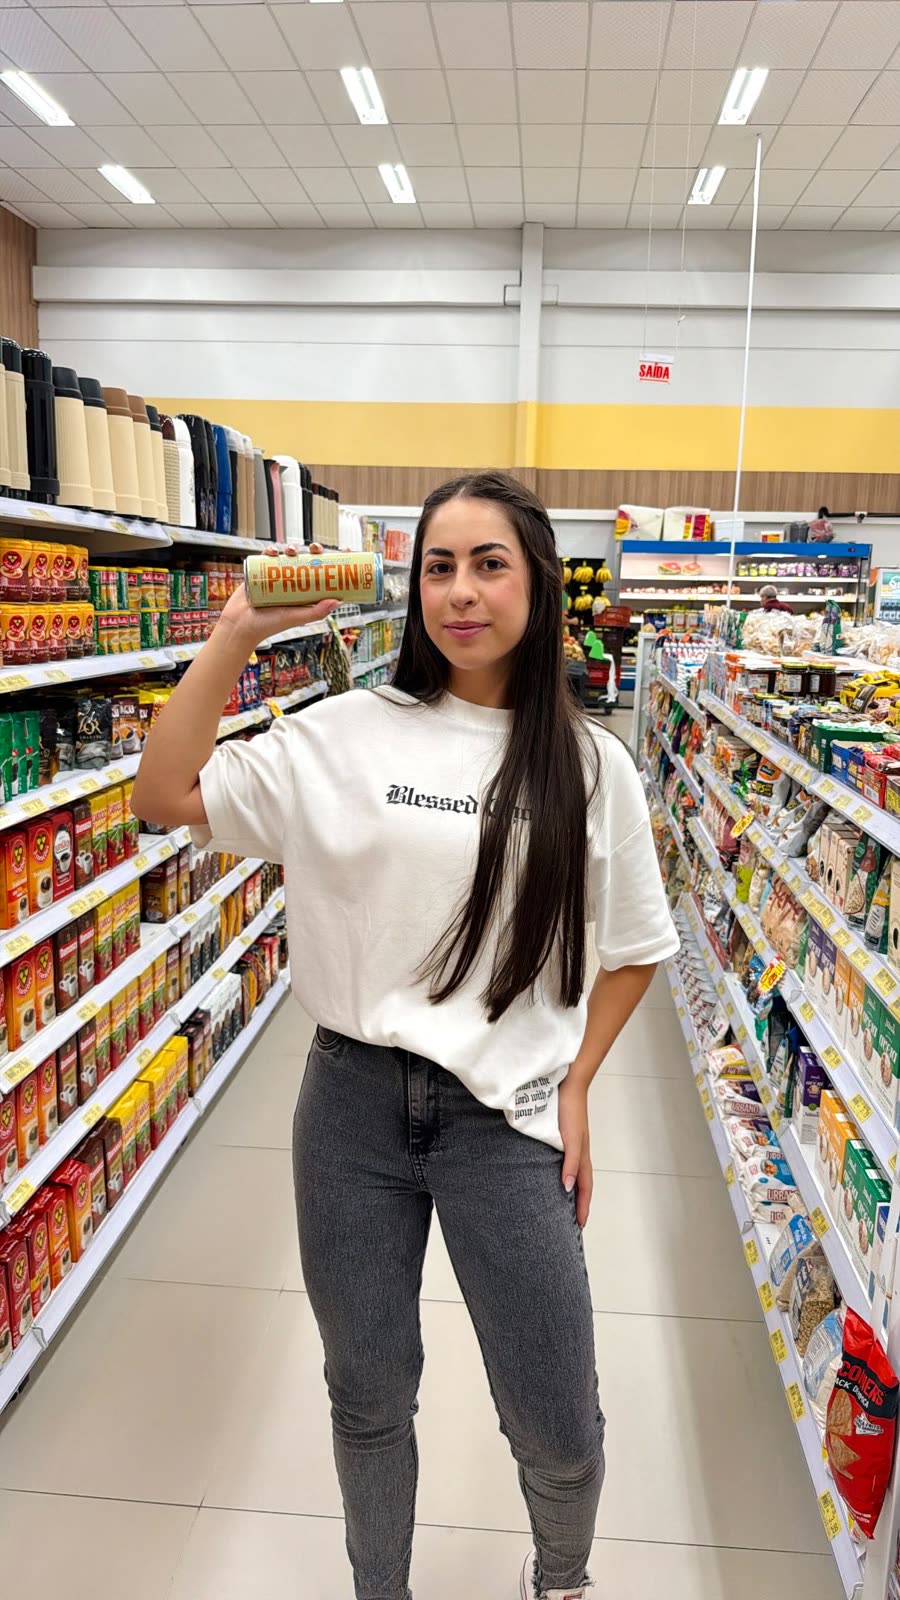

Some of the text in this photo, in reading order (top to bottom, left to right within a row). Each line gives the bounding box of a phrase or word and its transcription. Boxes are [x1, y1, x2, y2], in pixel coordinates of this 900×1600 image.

[639, 362, 669, 379] SAÍDA
[267, 563, 359, 593] PROTEIN
[363, 563, 373, 589] 20g
[386, 784, 479, 815] Blessed
[538, 1077, 550, 1087] the
[530, 1089, 547, 1102] with
[515, 1108, 533, 1121] your
[731, 1101, 759, 1114] URBANO
[767, 1189, 799, 1203] URBA
